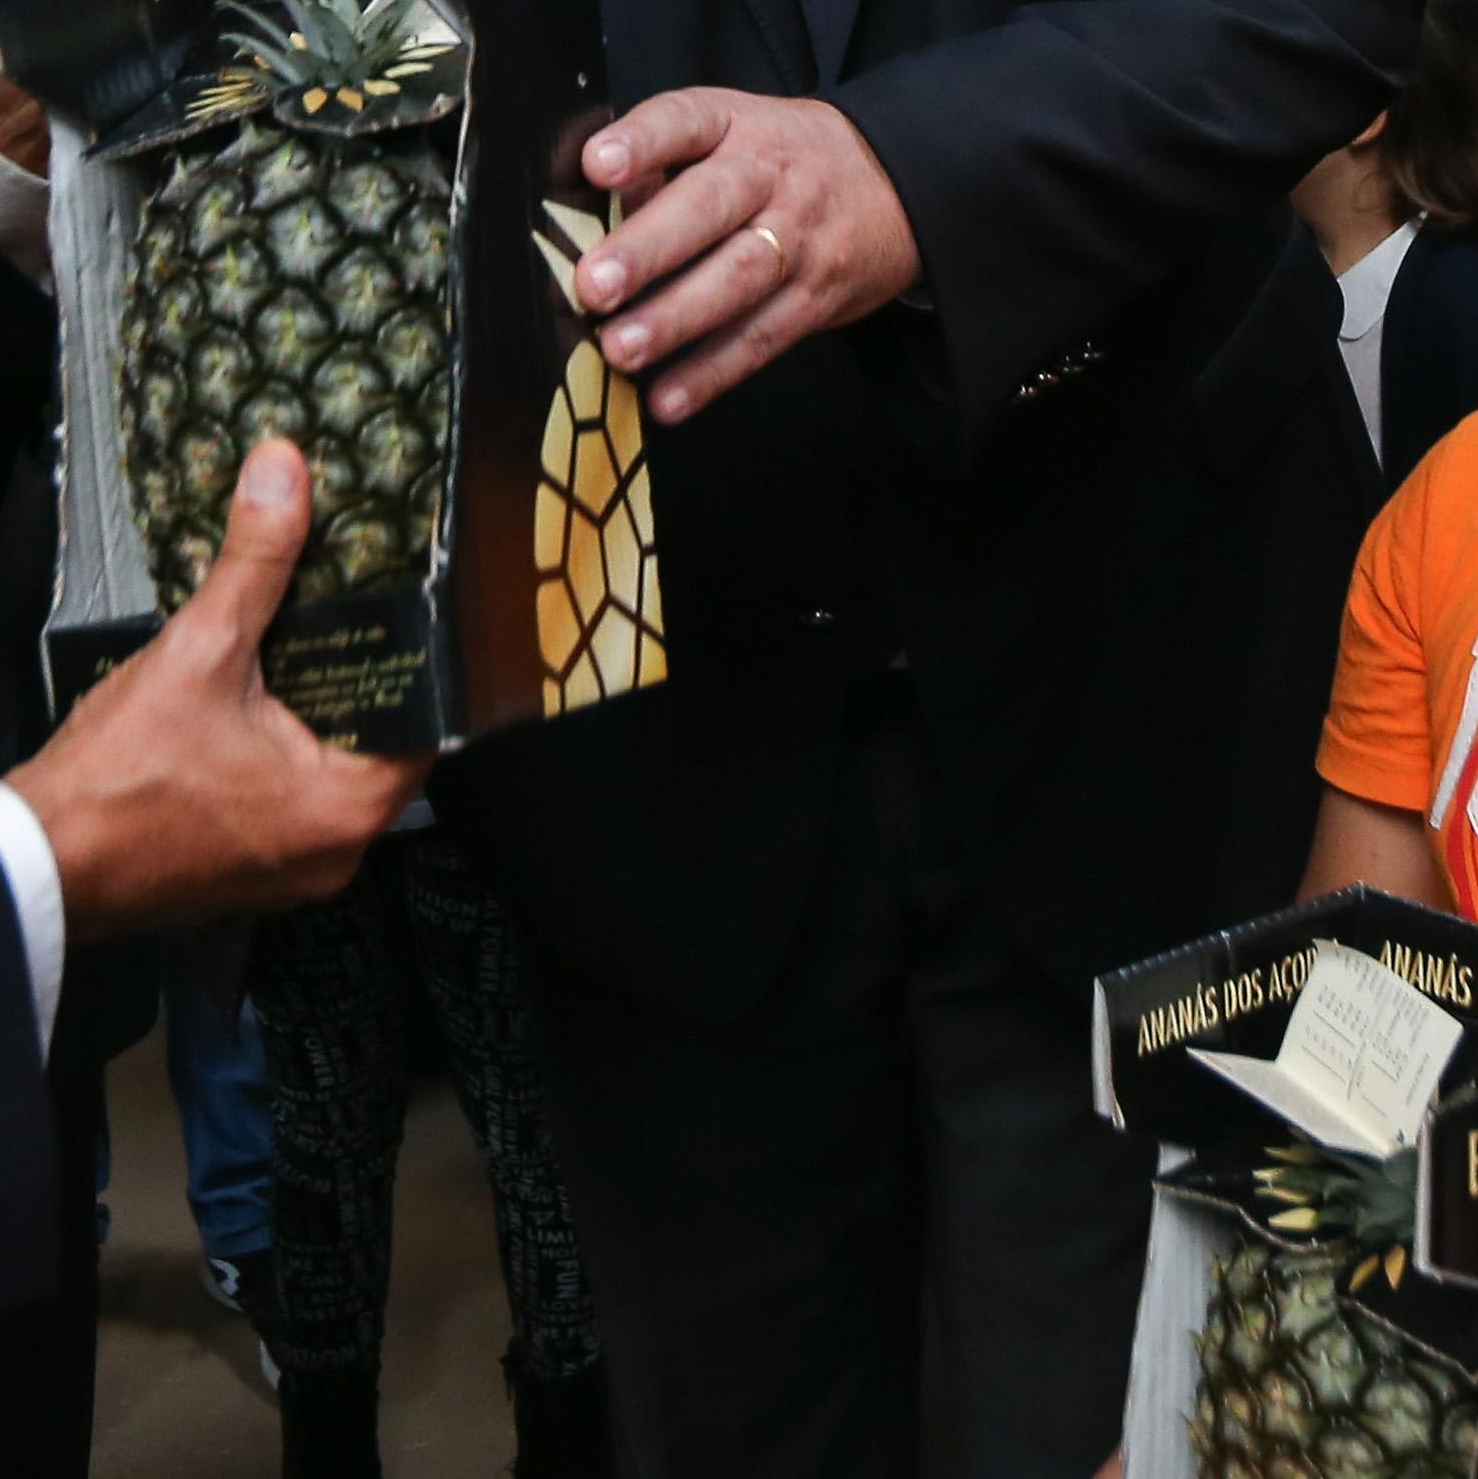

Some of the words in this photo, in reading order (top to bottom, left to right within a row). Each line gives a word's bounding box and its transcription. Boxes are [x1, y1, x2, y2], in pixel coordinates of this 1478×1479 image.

[1137, 982, 1219, 1058] ANANÁS
[1223, 967, 1264, 1021] DOS
[1378, 939, 1473, 1008] ANANÁS
